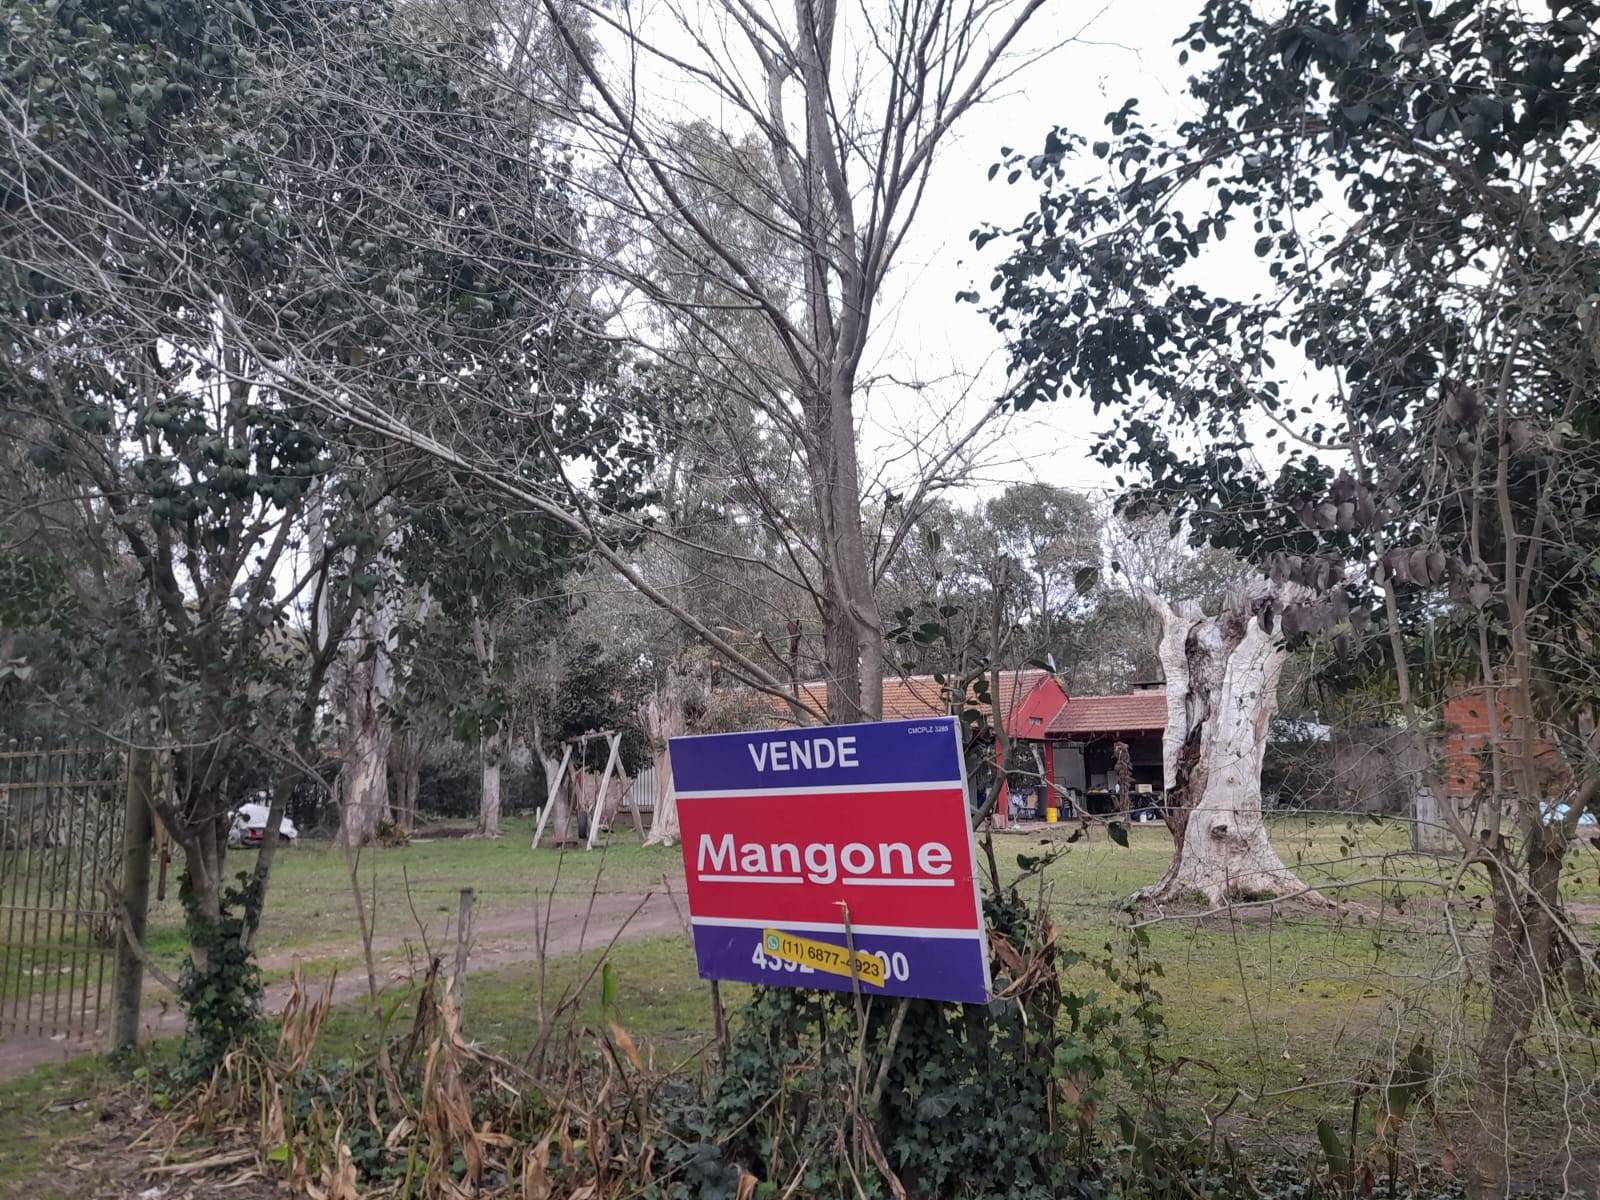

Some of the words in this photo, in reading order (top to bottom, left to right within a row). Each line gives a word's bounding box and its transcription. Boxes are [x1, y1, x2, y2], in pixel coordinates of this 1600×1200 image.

[748, 736, 859, 772] VENDE
[697, 833, 952, 885] Mangone
[782, 938, 804, 960] (11)
